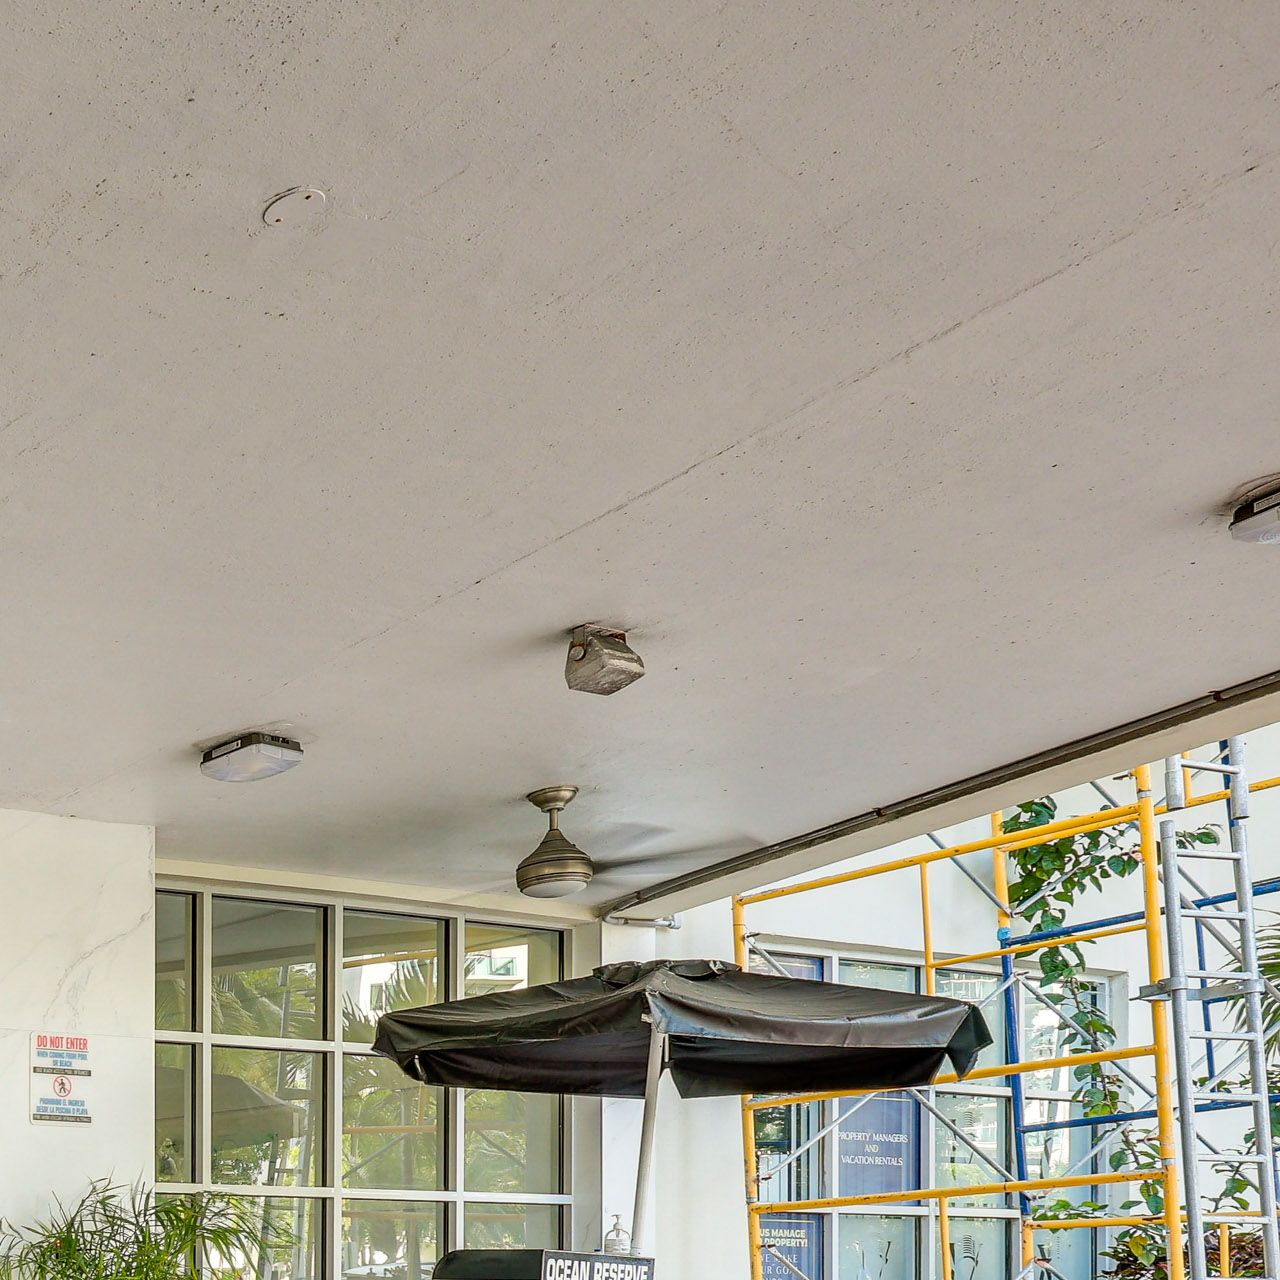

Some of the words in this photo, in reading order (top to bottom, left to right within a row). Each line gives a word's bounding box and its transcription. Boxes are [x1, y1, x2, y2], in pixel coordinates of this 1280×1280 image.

[37, 1035, 47, 1047] DO
[50, 1036, 64, 1048] NOT
[66, 1037, 88, 1050] ENTER
[838, 1131, 871, 1141] PROPERTY
[873, 1133, 908, 1143] MANAGERS
[864, 1144, 879, 1152] AND
[841, 1155, 874, 1165] VACATION
[875, 1156, 904, 1166] RENTALS
[771, 1229, 805, 1239] MANAGE
